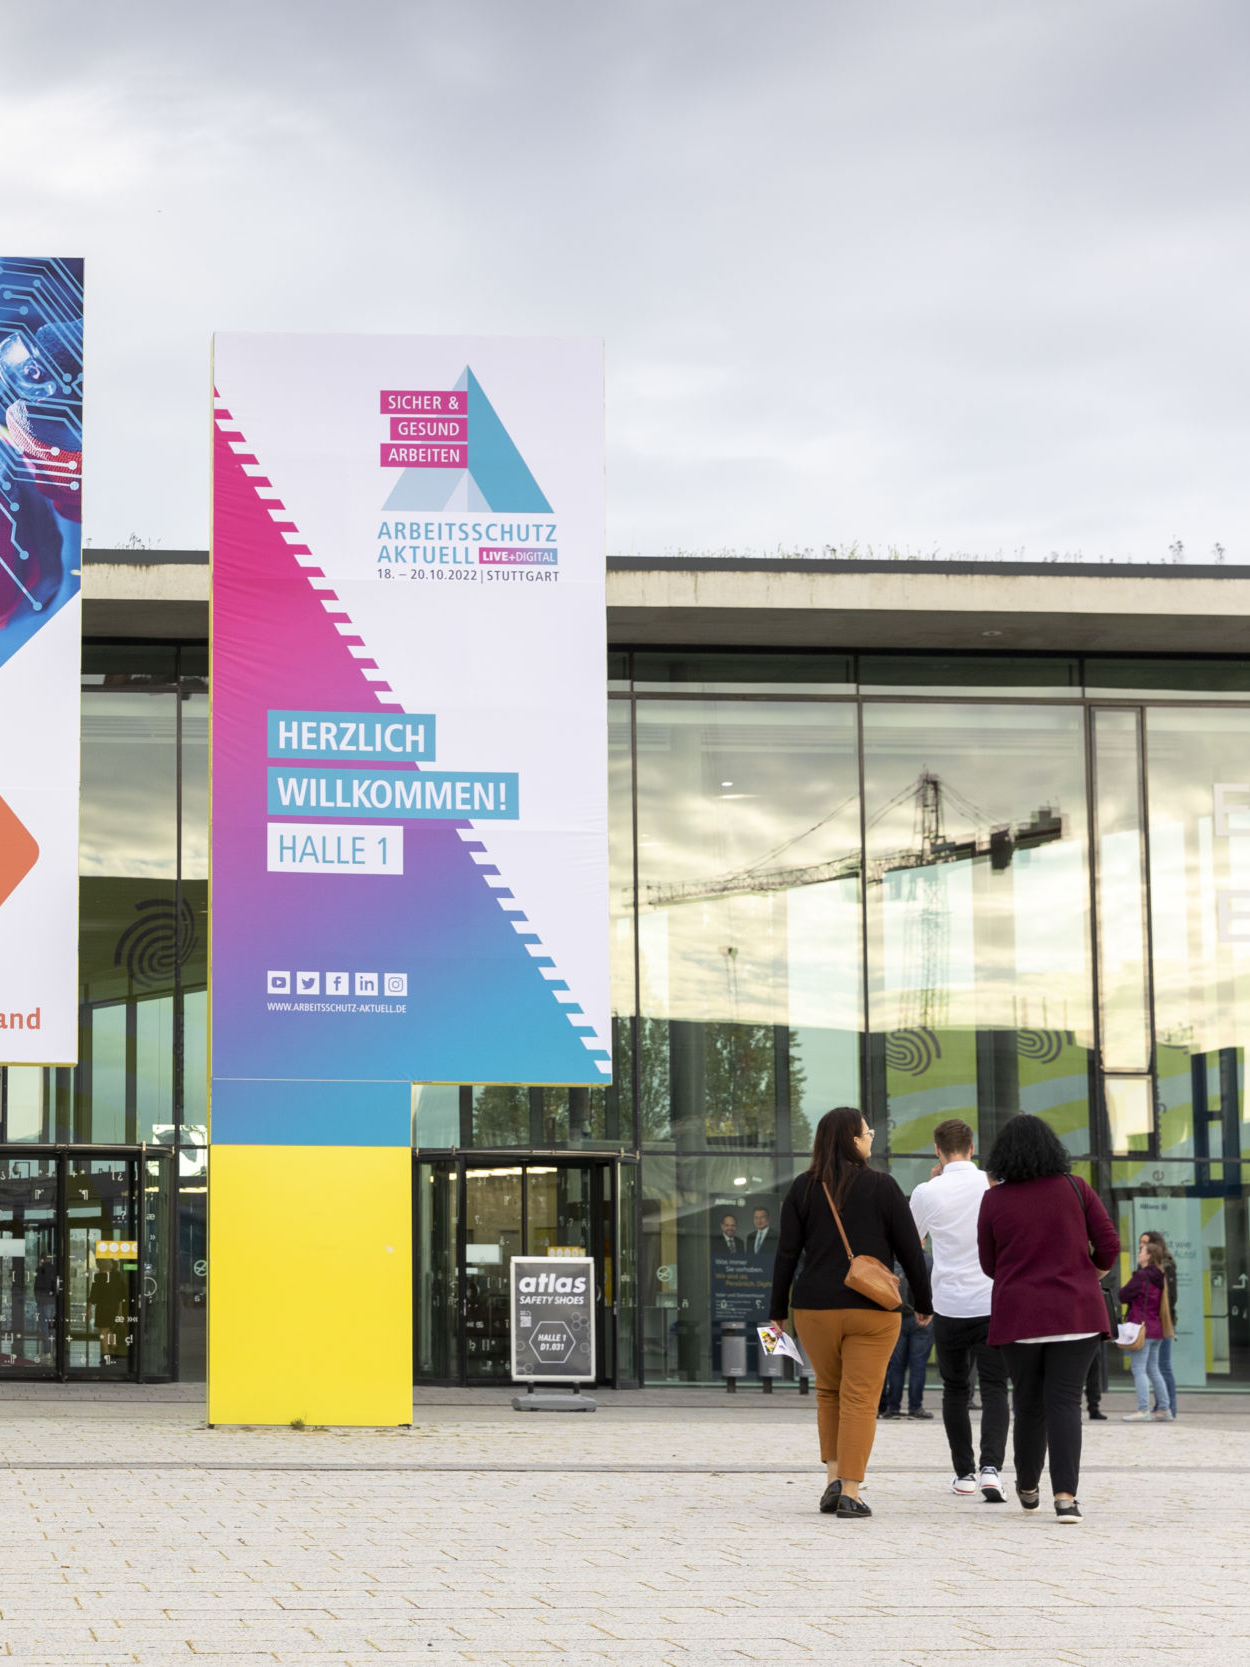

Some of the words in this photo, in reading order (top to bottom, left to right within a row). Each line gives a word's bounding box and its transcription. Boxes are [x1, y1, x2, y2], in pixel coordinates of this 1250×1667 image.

[388, 395, 442, 410] SICHER
[448, 396, 460, 410] &
[398, 421, 461, 437] GESUND
[388, 447, 461, 463] ARBEITEN
[377, 521, 558, 543] ARBEITSSCHUTZ
[377, 545, 475, 565] AKTUELL
[482, 551, 556, 563] LIVE+DIGITAL
[377, 568, 395, 580] 18.
[410, 569, 478, 581] 20.10.2022
[486, 570, 559, 582] STUTTGART
[278, 720, 426, 753] HERZLICH
[277, 777, 507, 811] WILLKOMMEN!
[279, 834, 366, 865] HALLE
[376, 836, 388, 865] 1
[267, 1002, 407, 1014] WWW.ARBEITSSCHUTZ-AKTUELL.DE
[518, 1272, 587, 1294] atlas
[518, 1295, 553, 1305] SAFETY
[553, 1295, 586, 1305] SHOES
[537, 1333, 561, 1342] HALLE
